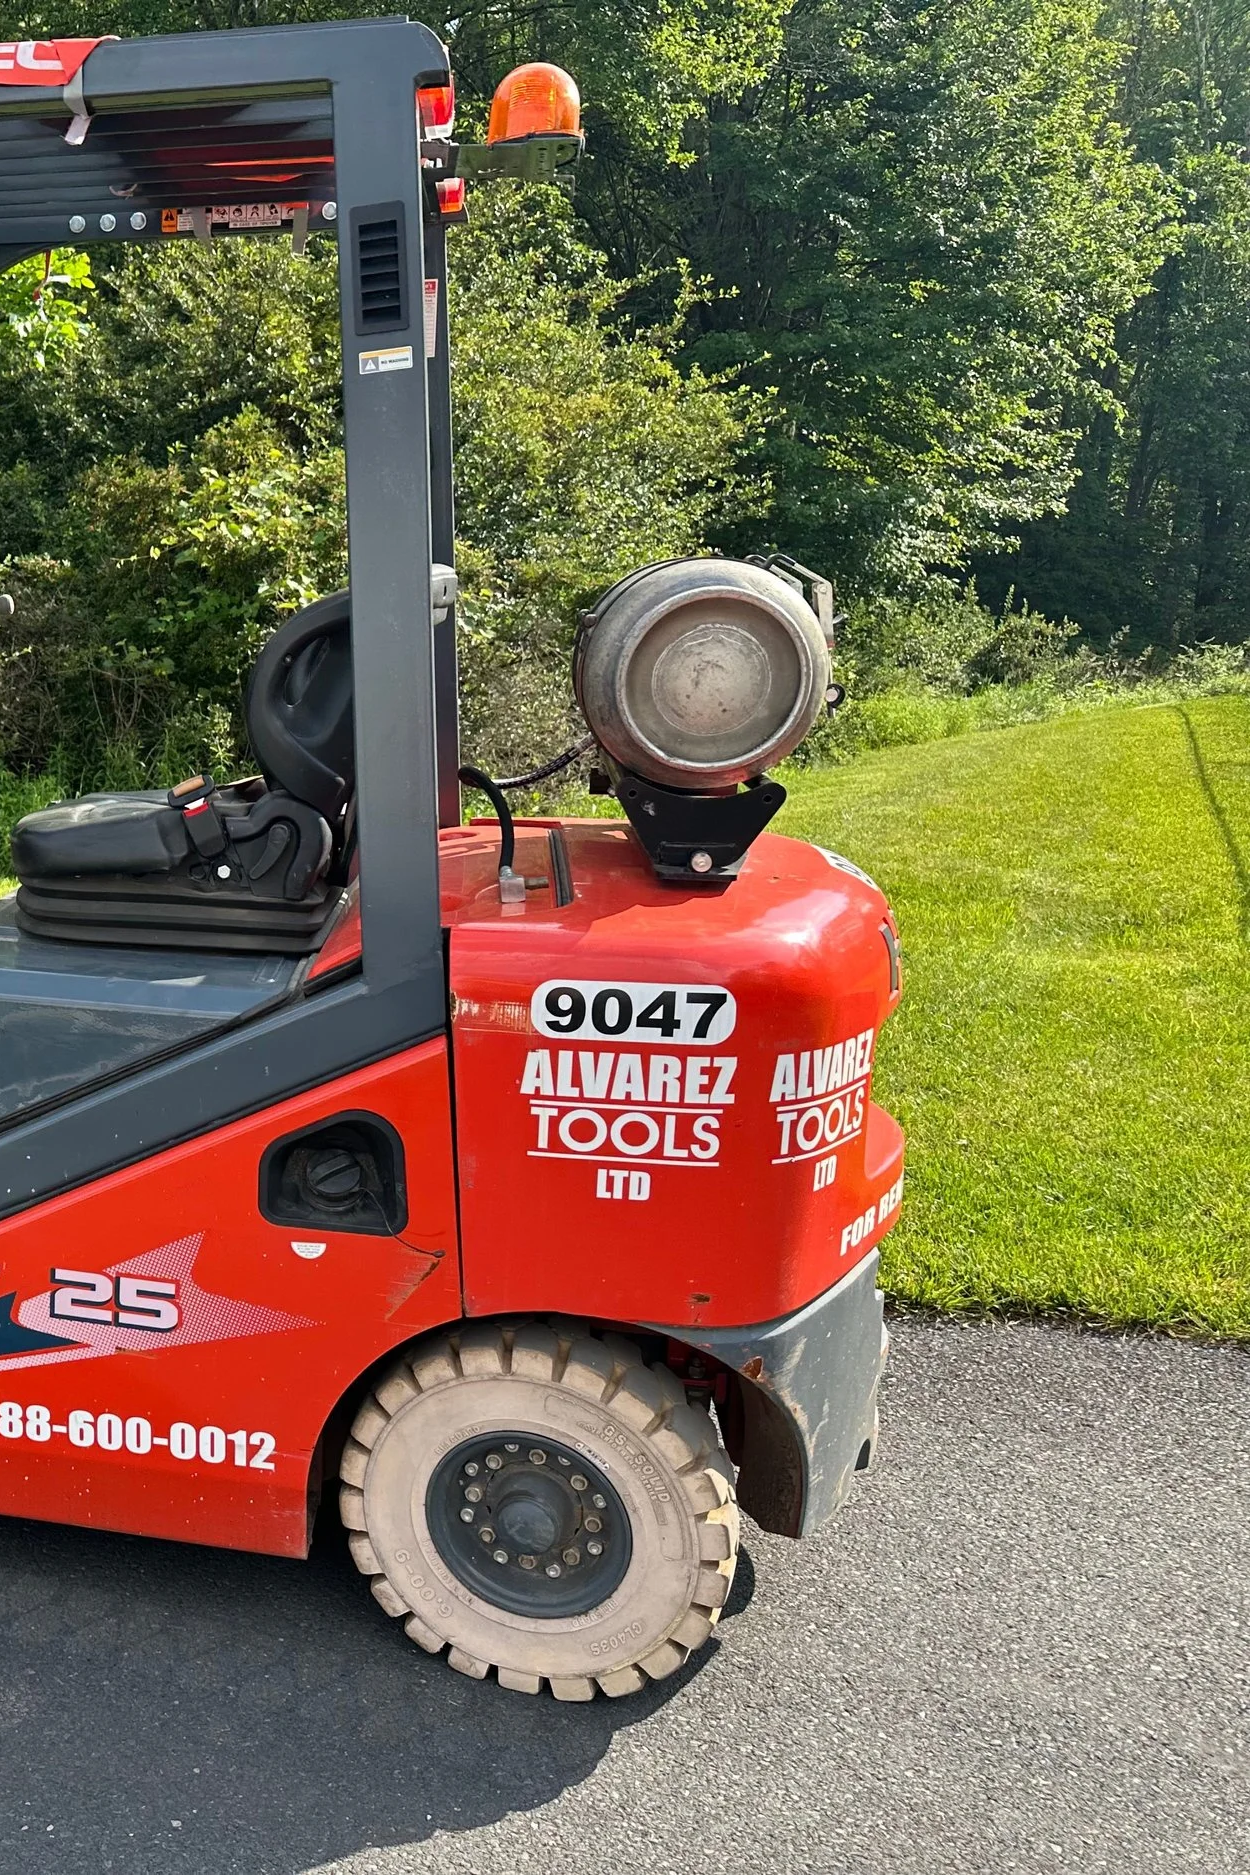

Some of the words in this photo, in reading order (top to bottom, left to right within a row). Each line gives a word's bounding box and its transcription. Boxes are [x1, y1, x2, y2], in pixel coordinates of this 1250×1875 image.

[545, 987, 728, 1039] 9047
[519, 1049, 738, 1104] ALVAREZ
[769, 1028, 874, 1103] ALVAREZ
[530, 1106, 720, 1159] TOOLS
[777, 1087, 865, 1155] TOOLS
[596, 1168, 651, 1201] LTD
[813, 1154, 837, 1192] LTD
[840, 1205, 876, 1257] FOR
[50, 1267, 179, 1333] 25
[604, 1425, 671, 1502] GS-SOLID
[395, 1549, 453, 1618] 6.00-9
[590, 1622, 643, 1656] GL403S
